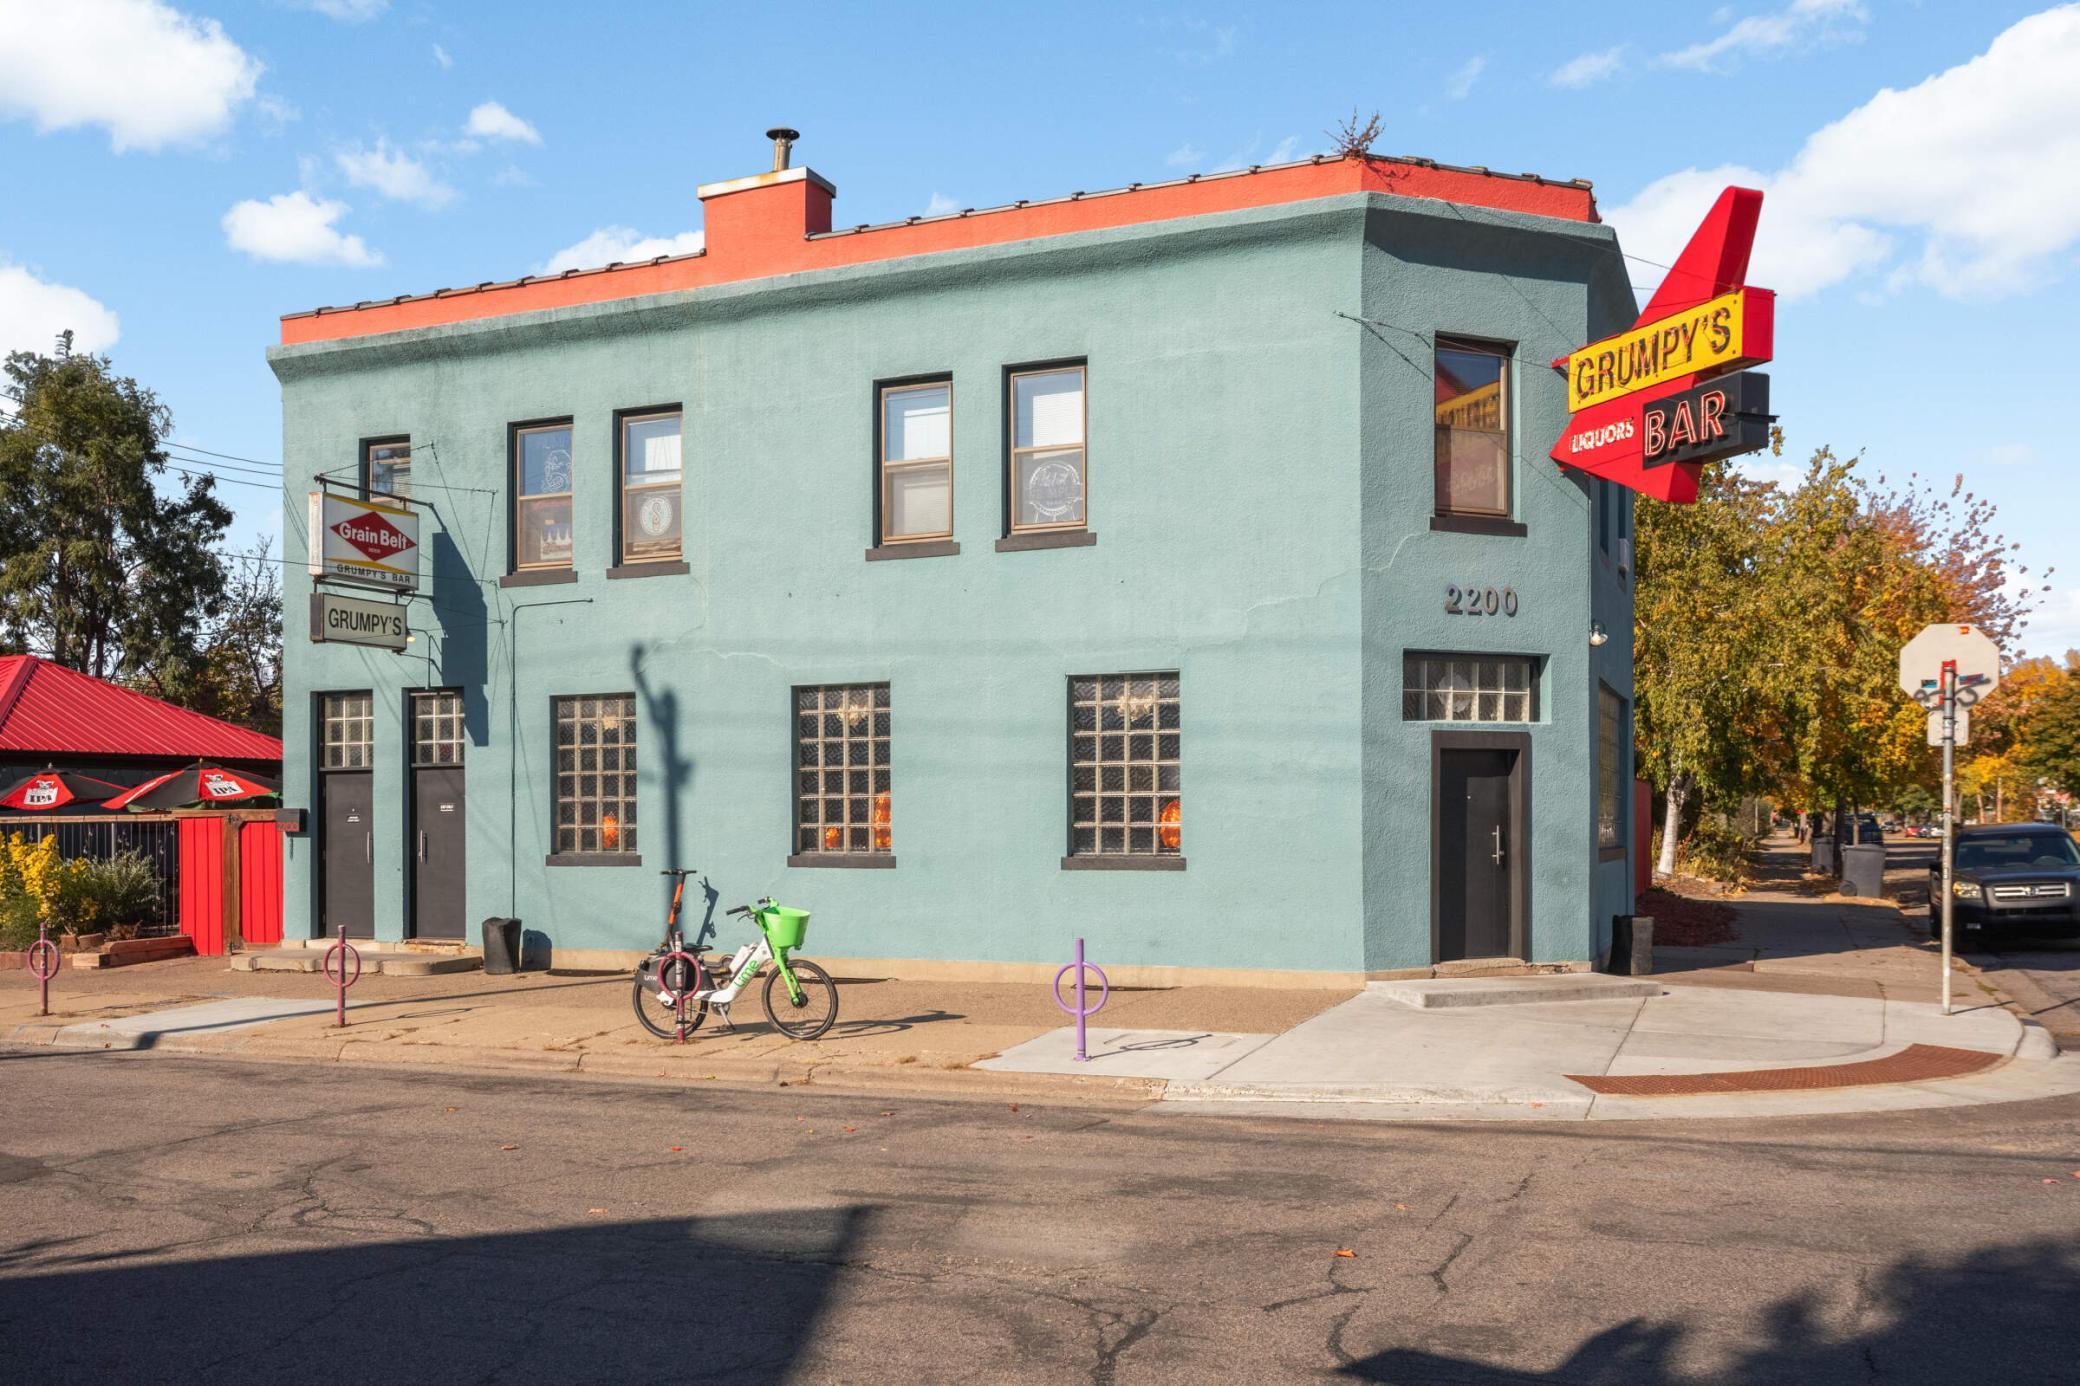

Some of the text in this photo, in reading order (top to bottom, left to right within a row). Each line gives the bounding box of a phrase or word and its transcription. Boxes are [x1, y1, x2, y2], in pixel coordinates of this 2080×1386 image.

[1576, 307, 1731, 399] GRUMPY'S
[1570, 421, 1634, 453] LIQUORS
[1644, 390, 1726, 457] BAR
[339, 522, 408, 550] Grain Belt
[336, 563, 411, 584] GRUMPY'S BAR
[1444, 584, 1518, 616] 2200
[328, 607, 402, 636] GRUMPY'S
[29, 794, 52, 803] IPA
[213, 786, 239, 795] IPA
[733, 959, 760, 987] Lime
